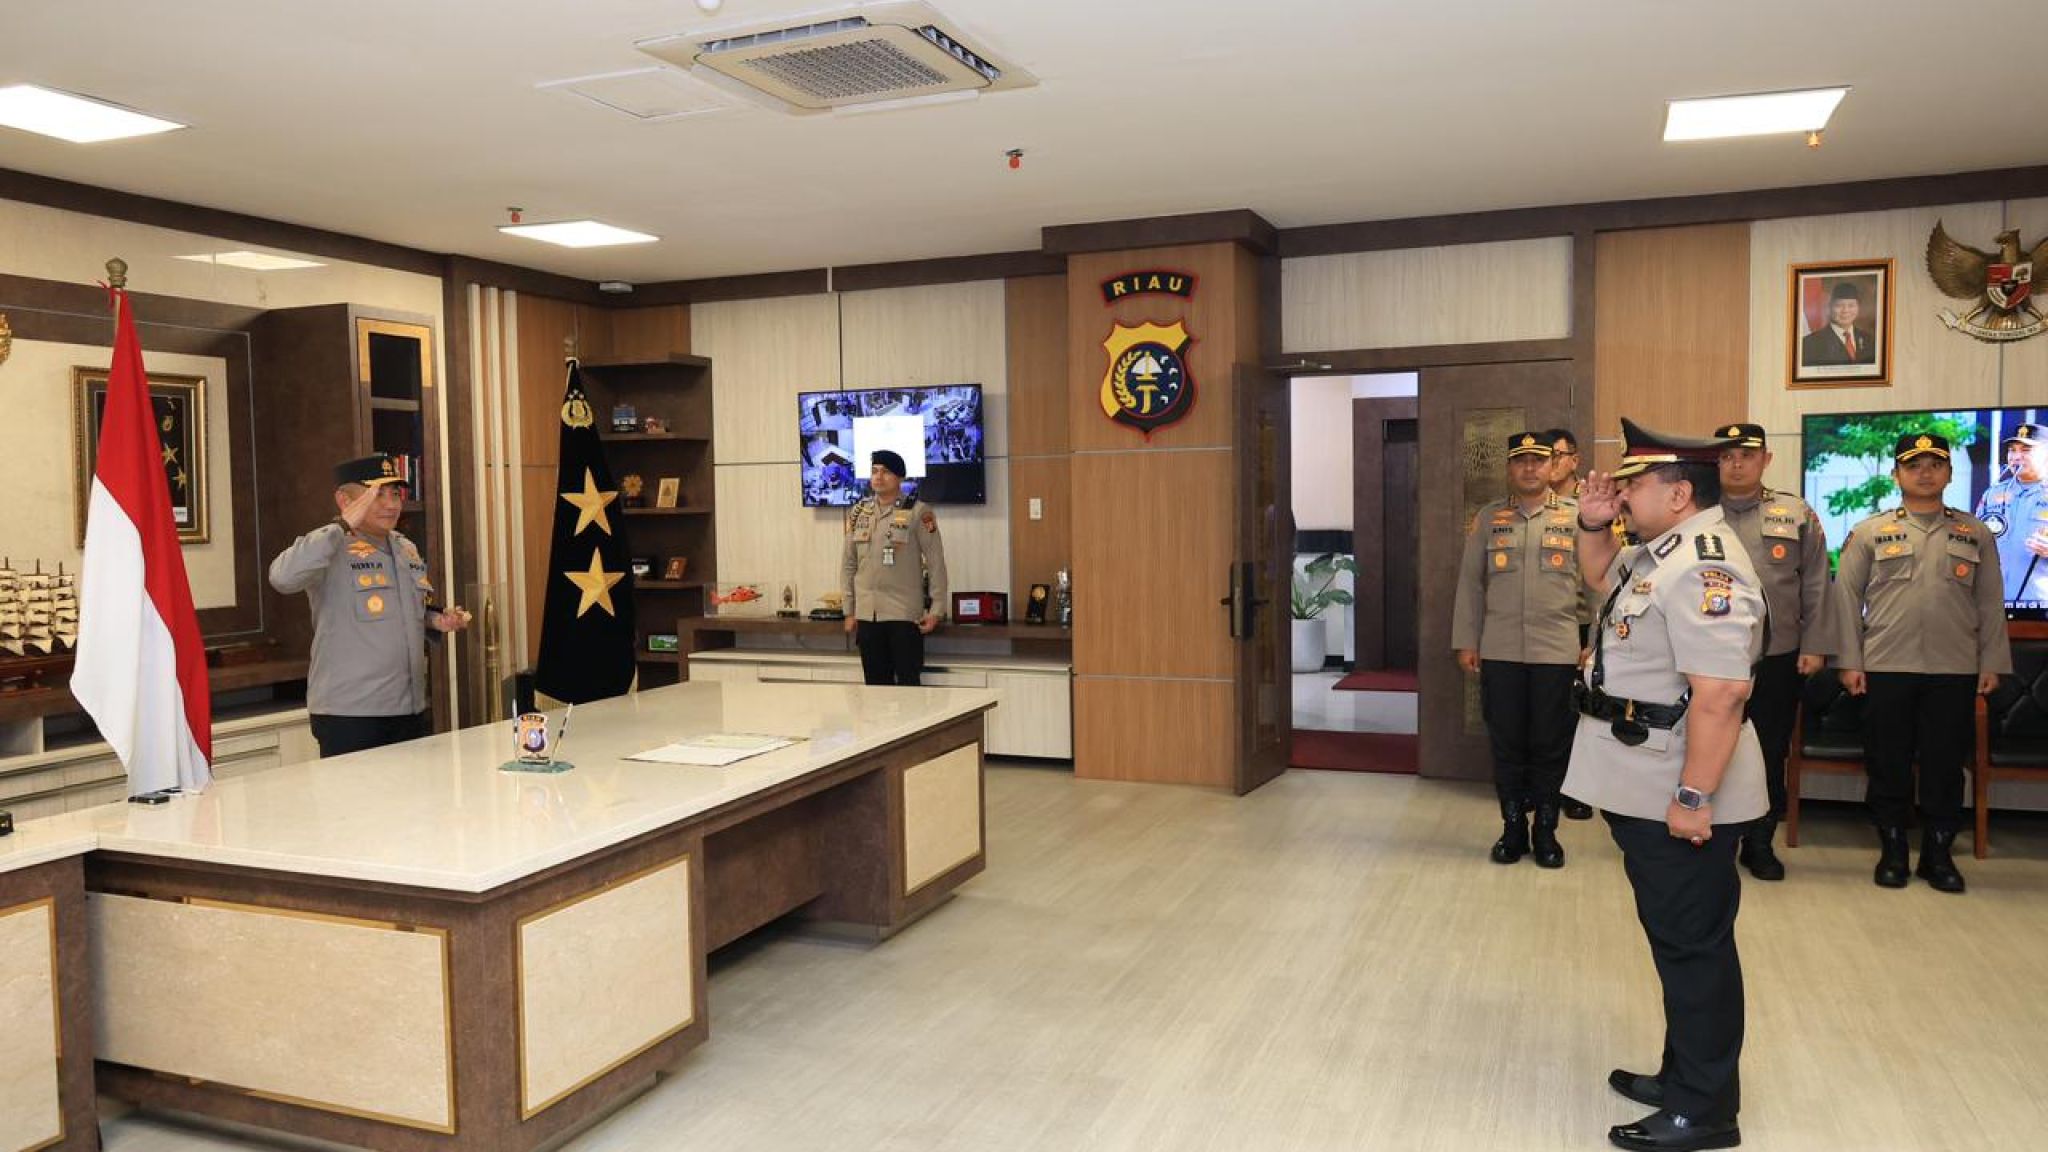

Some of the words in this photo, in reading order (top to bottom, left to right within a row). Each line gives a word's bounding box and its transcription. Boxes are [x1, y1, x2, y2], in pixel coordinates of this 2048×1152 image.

[1112, 274, 1185, 297] RIAU
[1764, 516, 1794, 524] POLRI
[1544, 526, 1573, 535] POLRI
